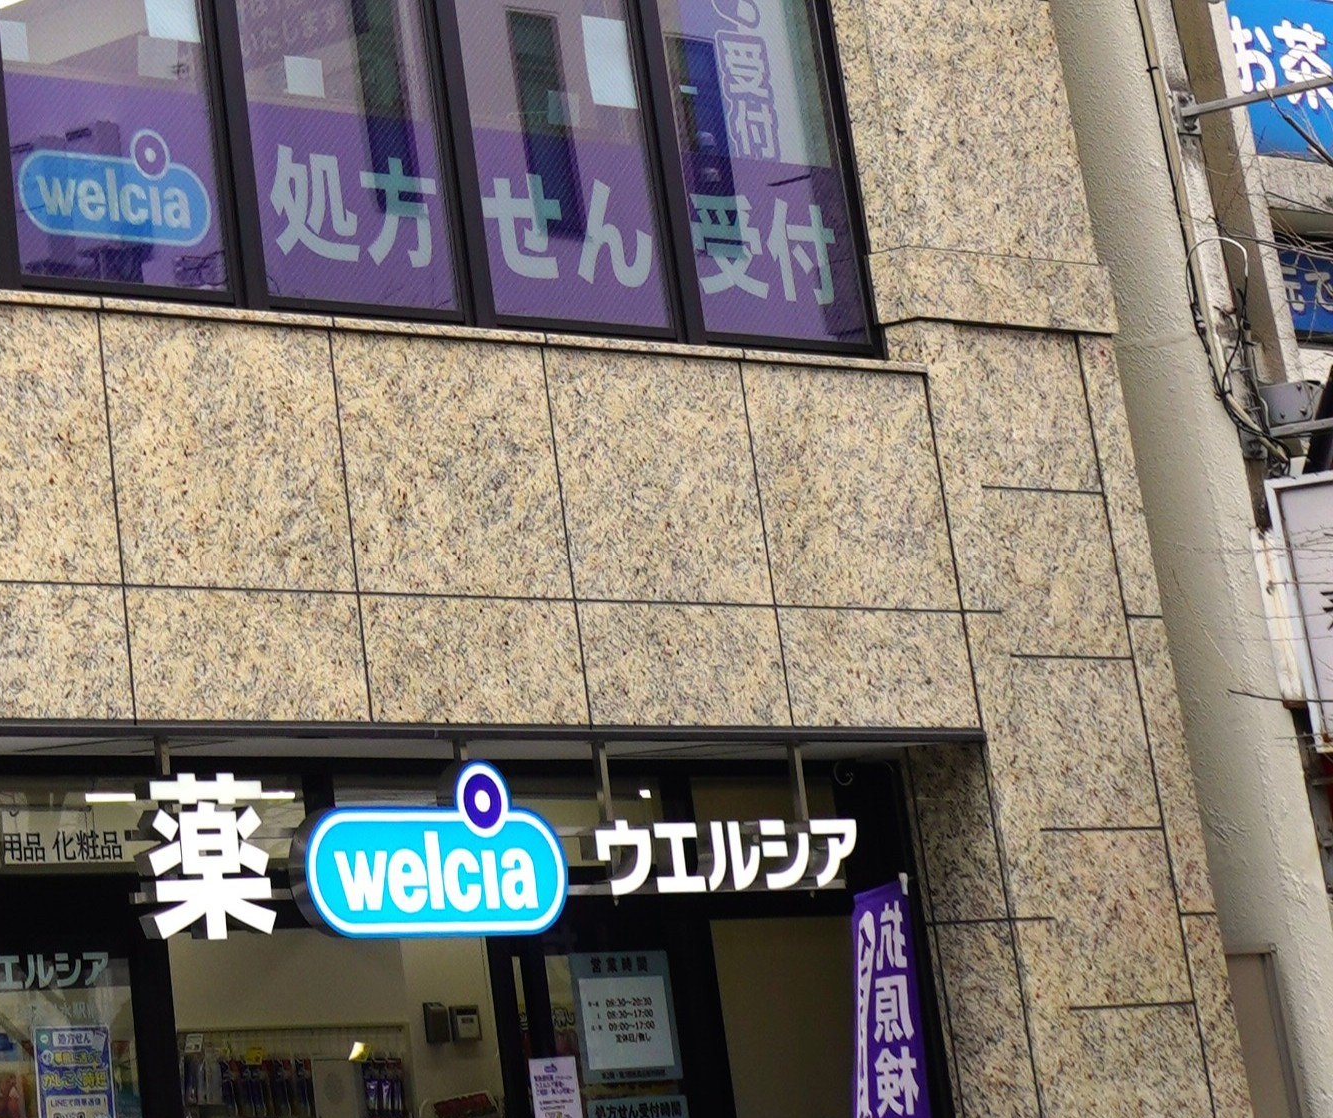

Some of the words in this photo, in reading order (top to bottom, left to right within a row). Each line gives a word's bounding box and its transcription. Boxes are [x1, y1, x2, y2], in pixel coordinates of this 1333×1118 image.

[36, 167, 192, 231] welcia
[149, 773, 276, 941] 薬
[334, 830, 539, 914] welcia
[595, 818, 857, 894] ウエルシア
[590, 955, 649, 974] 営業時間
